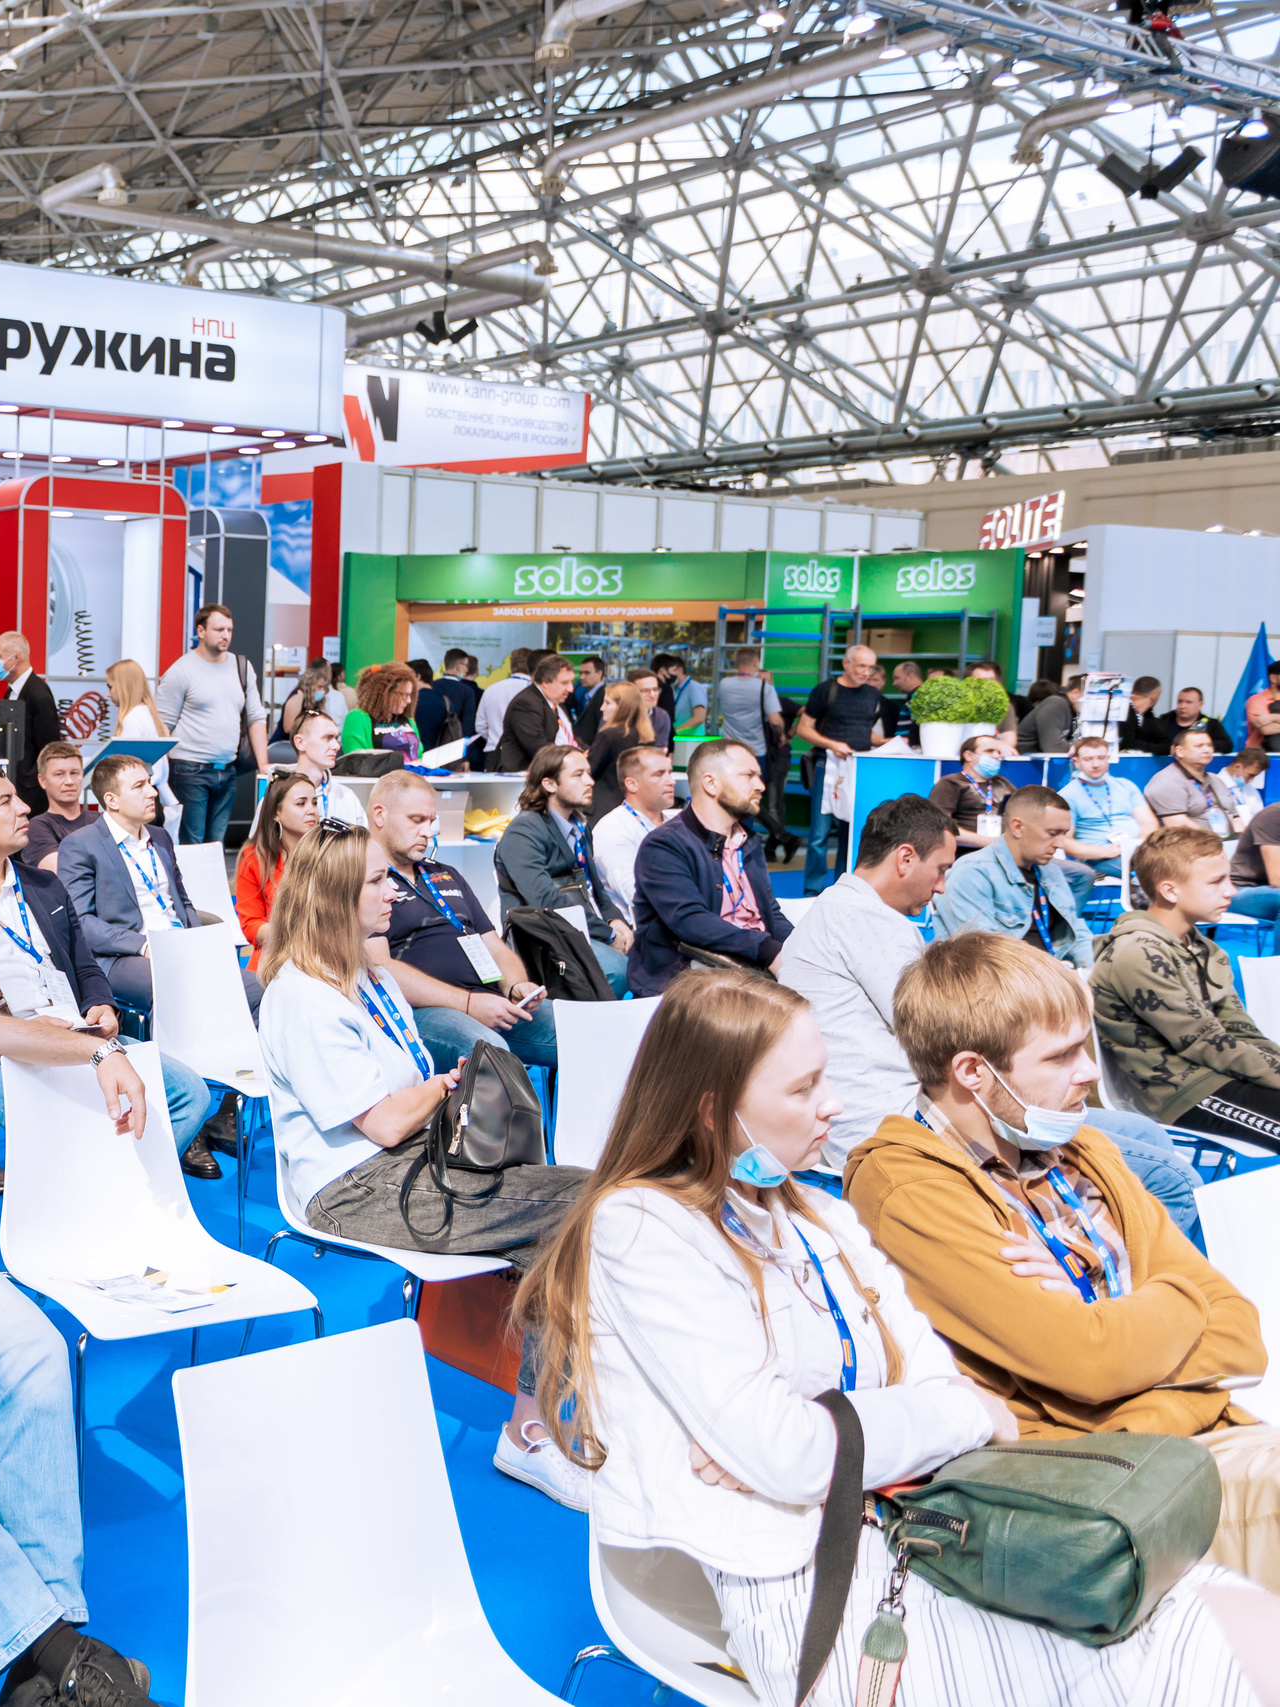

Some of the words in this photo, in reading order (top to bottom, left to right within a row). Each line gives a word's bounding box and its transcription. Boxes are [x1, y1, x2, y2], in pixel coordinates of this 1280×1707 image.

[192, 317, 236, 339] НПЦ
[426, 380, 570, 410] www.kann-group.com
[426, 407, 494, 424] СОБСТВЕННОЕ
[496, 412, 569, 433] ПРОИЗВОДСТВО
[454, 426, 520, 442] ЛОКАЛИЗАЦИЯ
[522, 433, 528, 443] В
[531, 434, 569, 446] РОССИИ
[514, 557, 623, 596] solos
[784, 560, 841, 592] solos
[896, 558, 976, 592] solos
[492, 607, 524, 617] ЗАВОД
[525, 606, 594, 616] СТЕЛЛАЖНОГО
[596, 606, 674, 617] ОБОРУДОВАНИЯ
